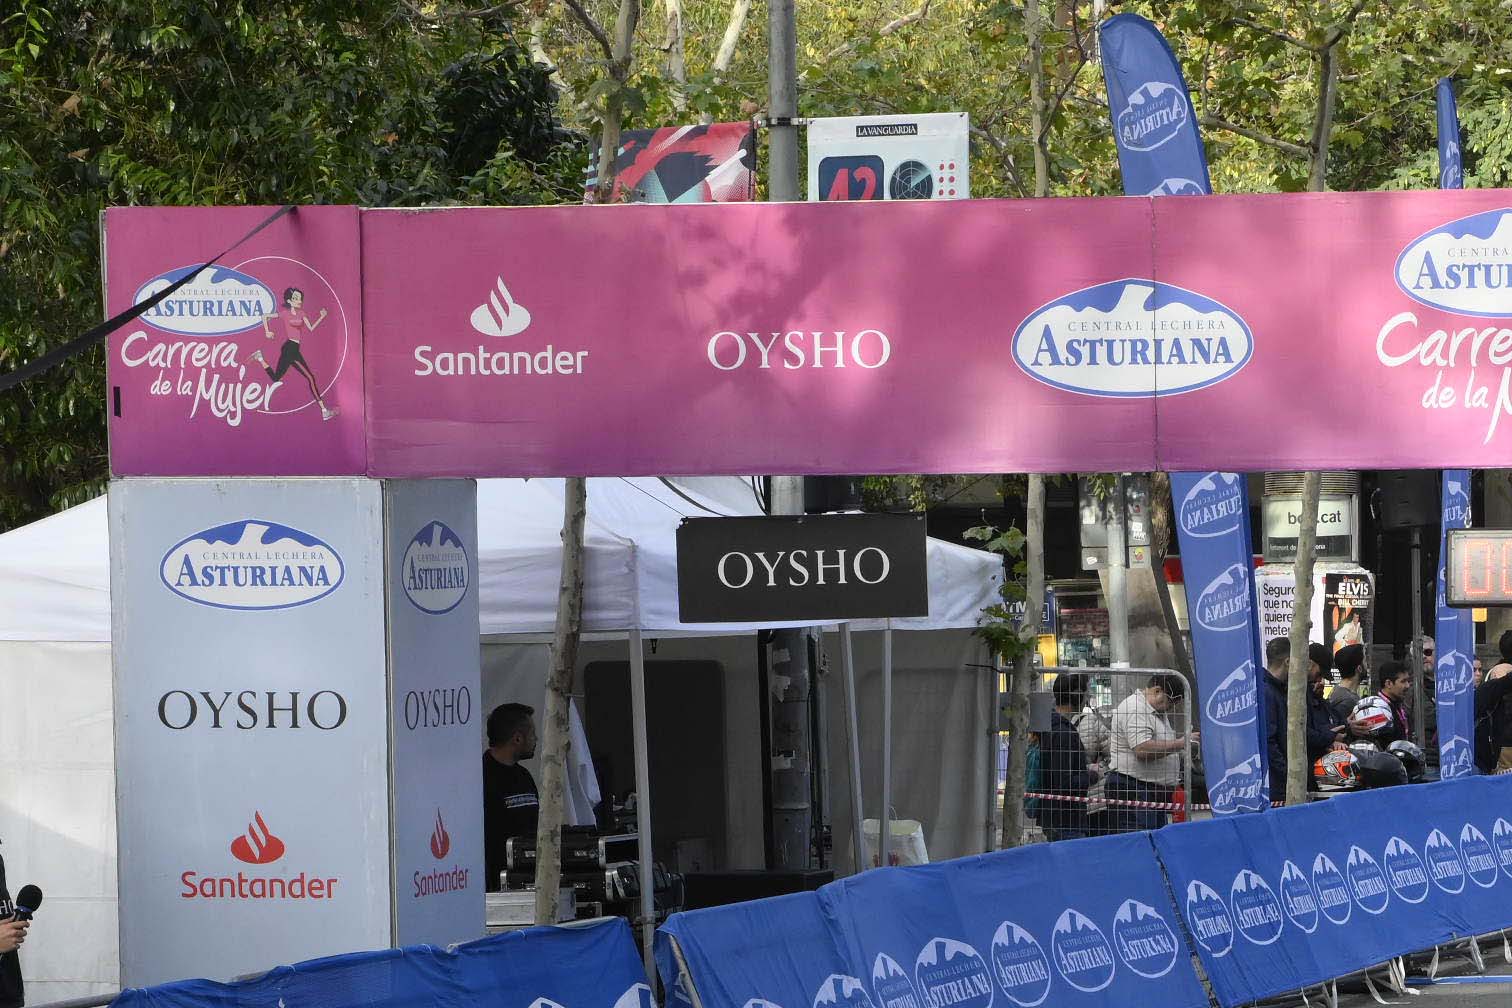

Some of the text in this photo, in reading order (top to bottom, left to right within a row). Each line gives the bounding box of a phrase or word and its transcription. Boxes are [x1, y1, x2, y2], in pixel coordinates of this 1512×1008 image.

[144, 292, 265, 317] ASTURIANA
[174, 288, 210, 296] ENTRAL
[1067, 319, 1226, 332] CENTRAL LECHERA
[121, 331, 241, 367] Carrera
[414, 345, 589, 376] Santander
[707, 328, 891, 371] OYSHO
[1031, 324, 1234, 366] ASTURIANA
[150, 365, 283, 427] de la Mujer
[1421, 370, 1457, 409] de
[1463, 369, 1490, 409] la
[174, 554, 331, 587] ASTURIANA
[202, 551, 325, 561] CENTRAL LECHERA
[717, 547, 890, 589] OYSHO
[408, 557, 466, 592] ASTURIANA
[1338, 582, 1369, 595] ELVIS
[1264, 600, 1280, 611] que
[1264, 606, 1293, 623] quiere
[157, 690, 347, 730] OYSHO
[404, 686, 472, 731] OYSHO
[181, 871, 338, 899] Santander
[413, 865, 469, 898] Santander
[997, 957, 1047, 988] ASTURIANA
[1060, 943, 1113, 974] ASTURIANA
